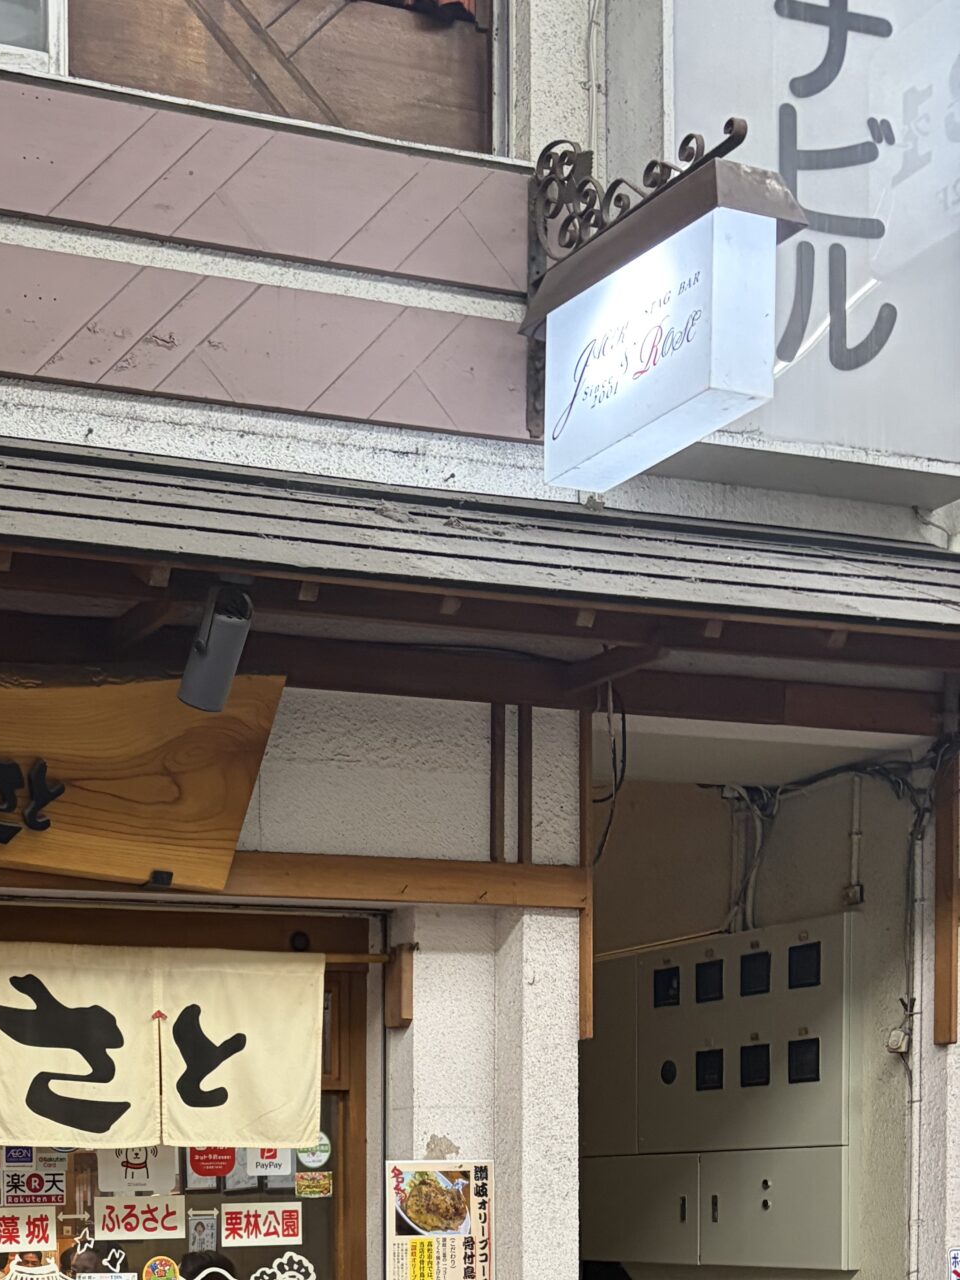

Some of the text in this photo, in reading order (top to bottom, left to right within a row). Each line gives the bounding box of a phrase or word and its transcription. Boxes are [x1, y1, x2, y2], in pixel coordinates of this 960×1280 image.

[678, 271, 700, 295] BAR
[255, 1160, 283, 1171] PayPay
[7, 1195, 48, 1203] Rakuten
[101, 1203, 179, 1233] ふるさと
[224, 1209, 300, 1241] 栗林公園
[462, 1236, 476, 1280] 骨付鳥
